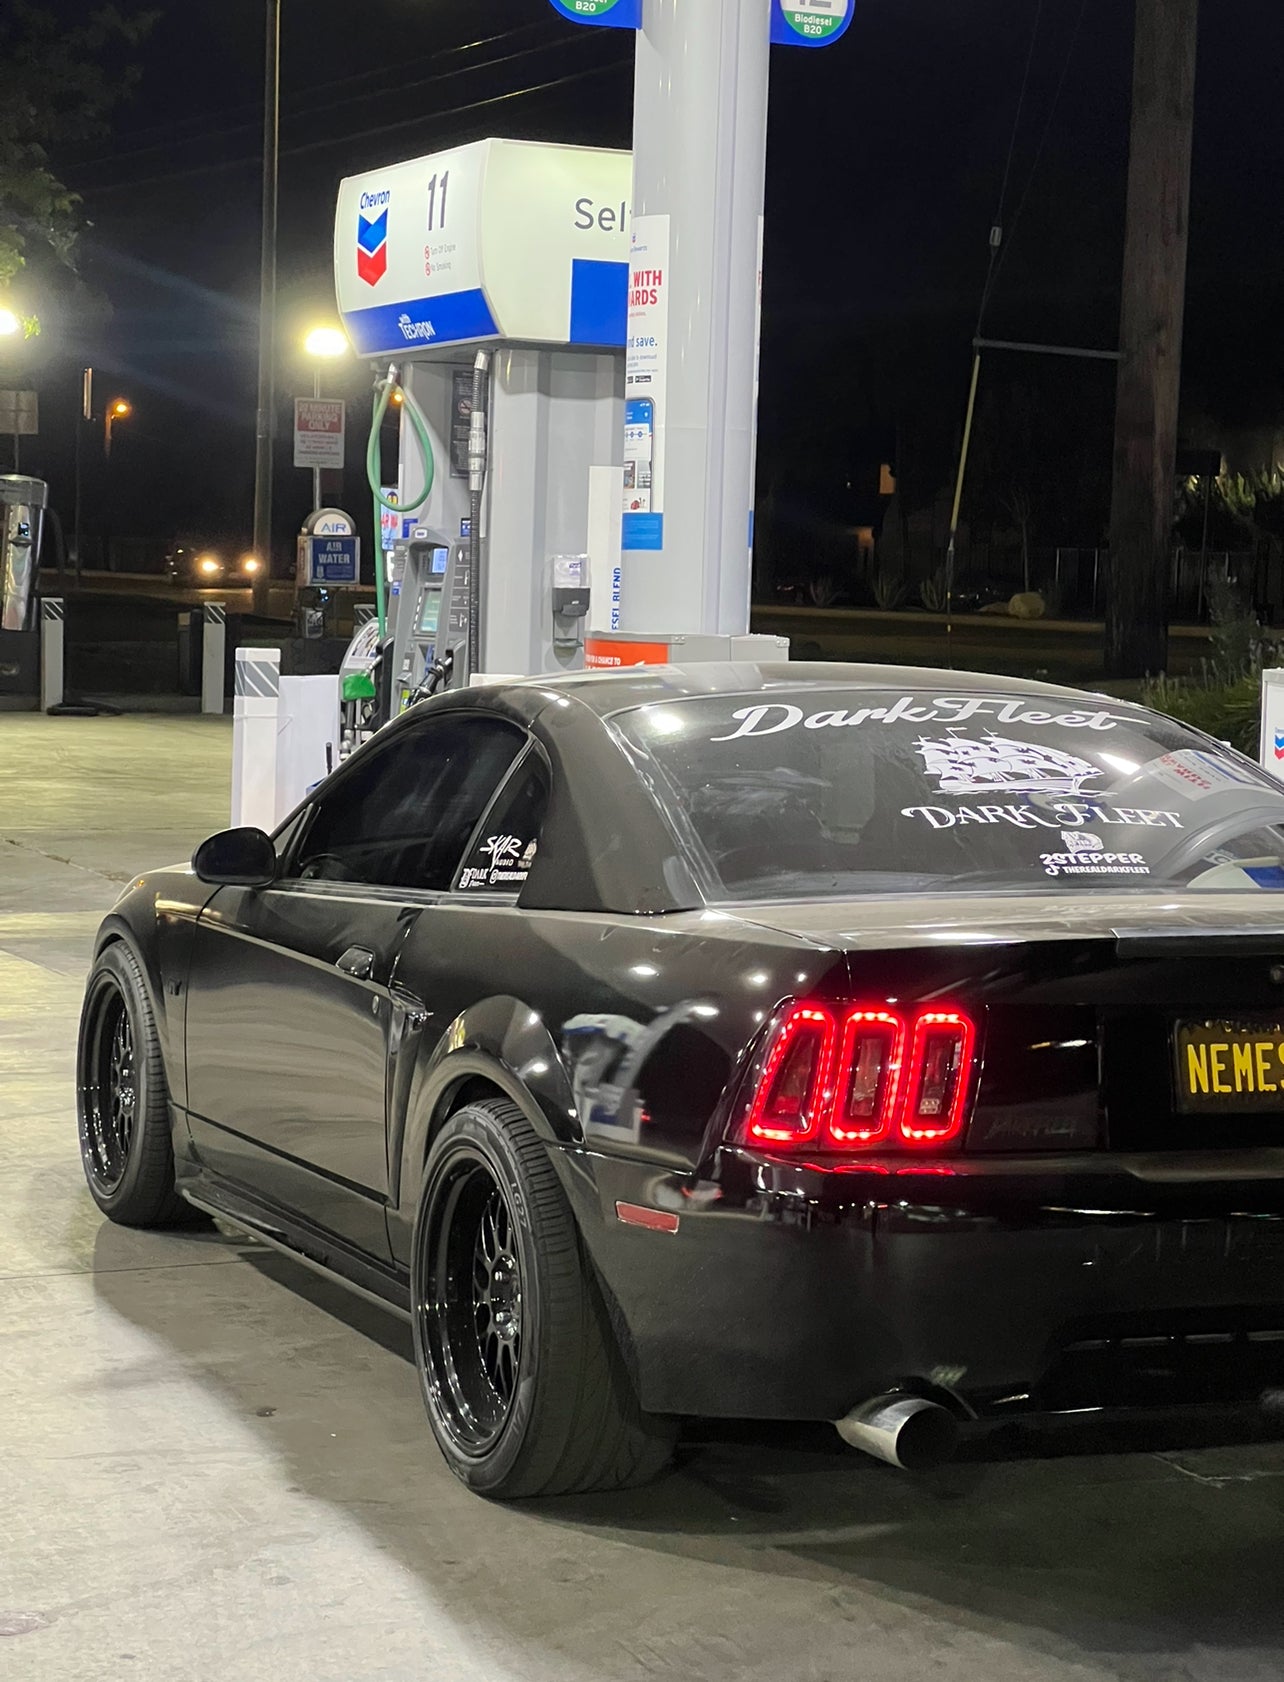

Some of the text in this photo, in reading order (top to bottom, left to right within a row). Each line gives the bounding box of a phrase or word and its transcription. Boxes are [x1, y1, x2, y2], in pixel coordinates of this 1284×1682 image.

[575, 1, 596, 12] B20
[794, 13, 832, 26] Biodiesel
[803, 24, 822, 35] B20
[360, 190, 390, 209] Chevron
[427, 170, 449, 231] 11
[574, 197, 632, 232] Sel
[633, 269, 662, 288] WITH
[629, 288, 658, 307] ARDS
[398, 320, 436, 340] TECHRON
[635, 336, 658, 348] save.
[311, 402, 341, 412] MINUTE
[301, 410, 338, 421] PARKING
[309, 420, 331, 430] ONLY
[320, 523, 347, 533] AIR
[326, 541, 342, 552] AIR
[318, 553, 350, 564] WATER
[614, 657, 621, 666] TO
[901, 803, 1185, 829] DARK FLEET
[1039, 852, 1147, 865] 2STEPPER
[1062, 866, 1151, 874] THEREALDARKFLEET
[1187, 1042, 1284, 1094] NEME
